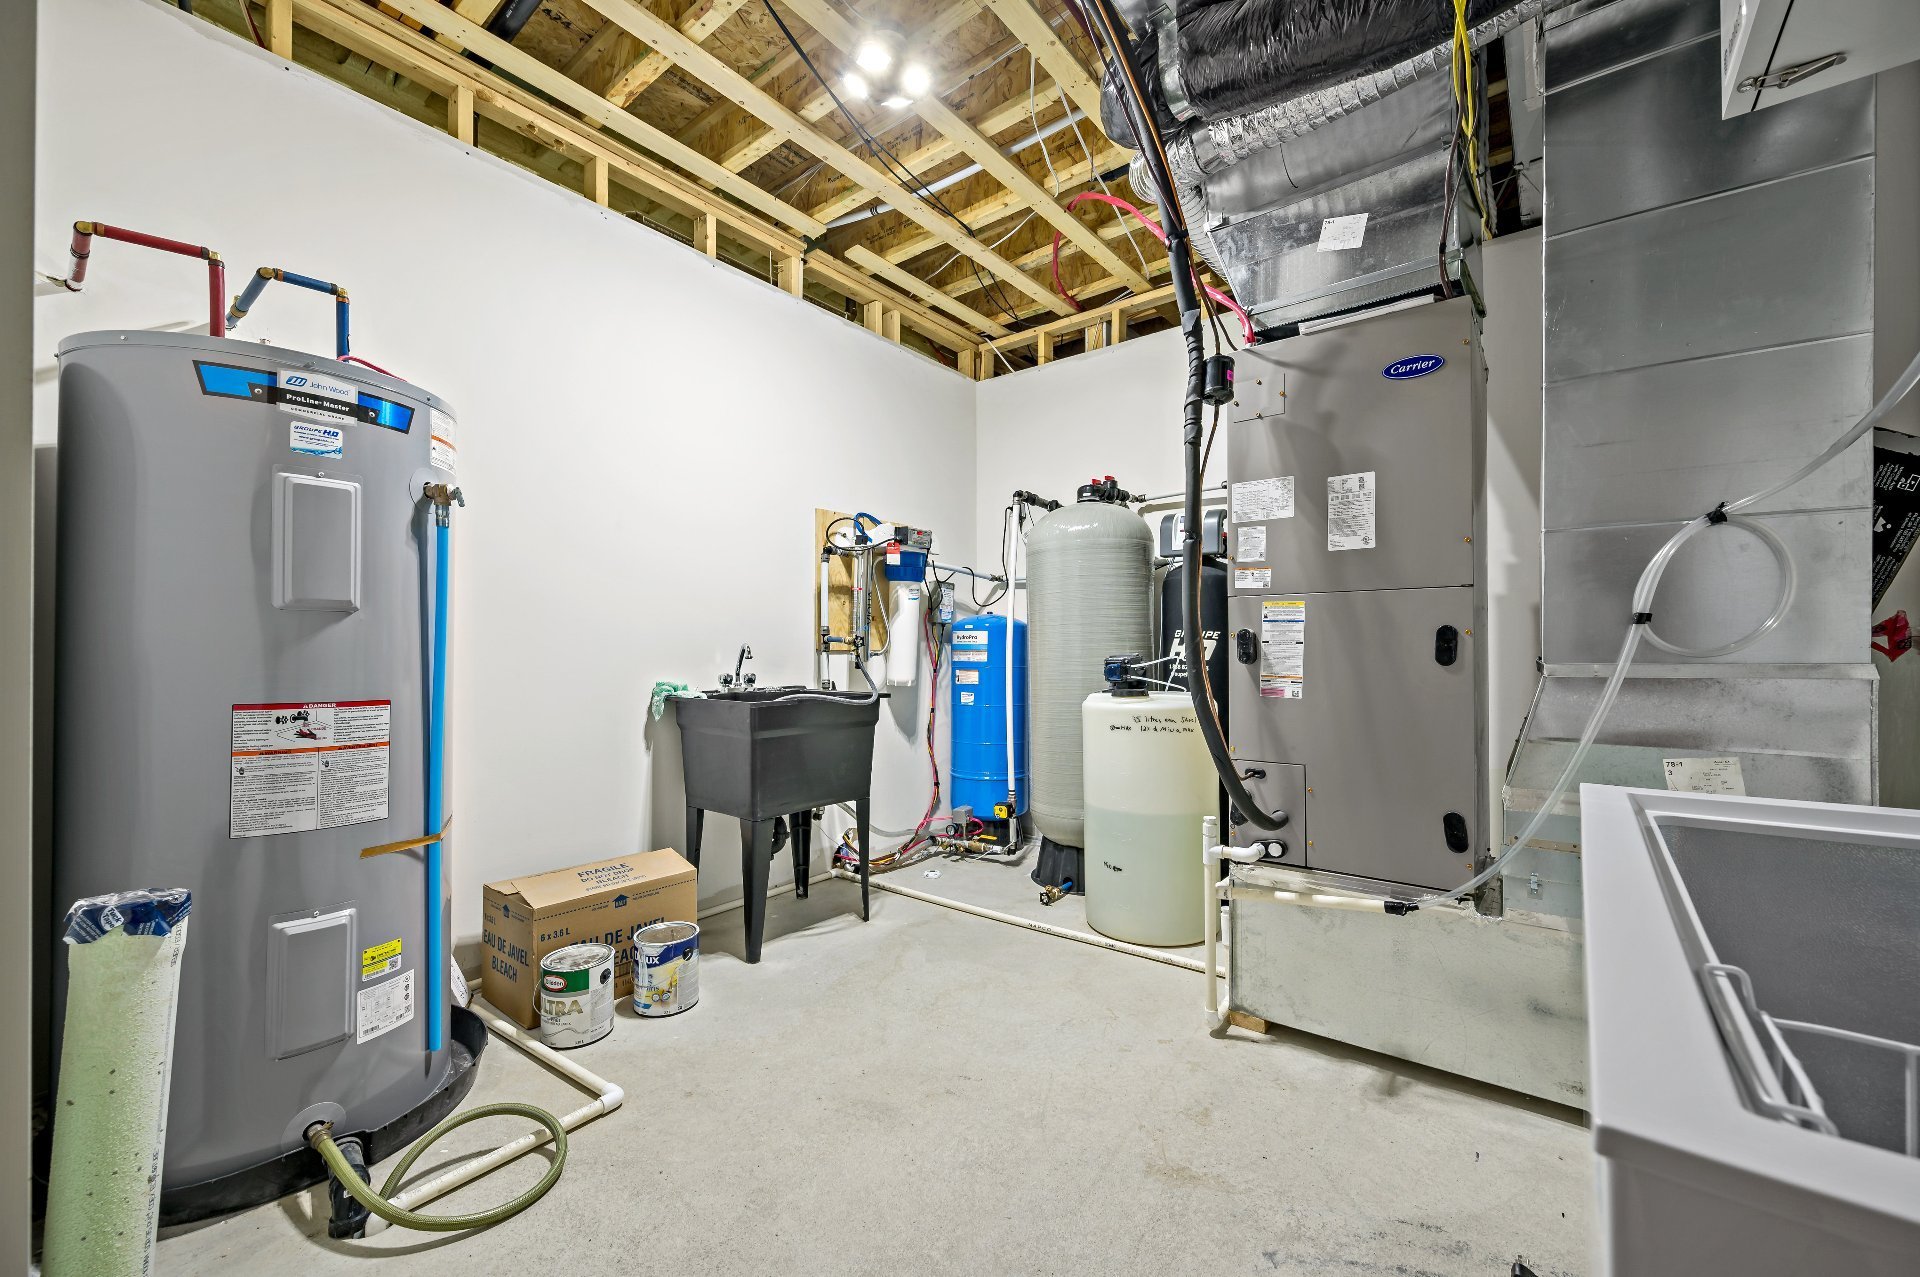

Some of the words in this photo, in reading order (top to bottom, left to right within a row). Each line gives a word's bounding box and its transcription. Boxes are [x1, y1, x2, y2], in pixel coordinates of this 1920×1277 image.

[1390, 360, 1436, 375] Carrier
[309, 381, 328, 393] John
[328, 386, 350, 397] Wood
[323, 400, 350, 412] Master
[1174, 630, 1221, 640] GPE
[577, 863, 629, 878] FRAGILE
[613, 867, 634, 876] DROP
[596, 874, 629, 885] BLEACH
[101, 914, 116, 929] Tape
[107, 906, 122, 923] Tuck
[540, 933, 546, 942] 6
[553, 929, 564, 939] 3.6
[605, 929, 623, 946] DE
[483, 929, 496, 948] EAU
[497, 936, 507, 954] DE
[507, 943, 530, 967] JAVEL
[492, 955, 518, 984] BLEACH
